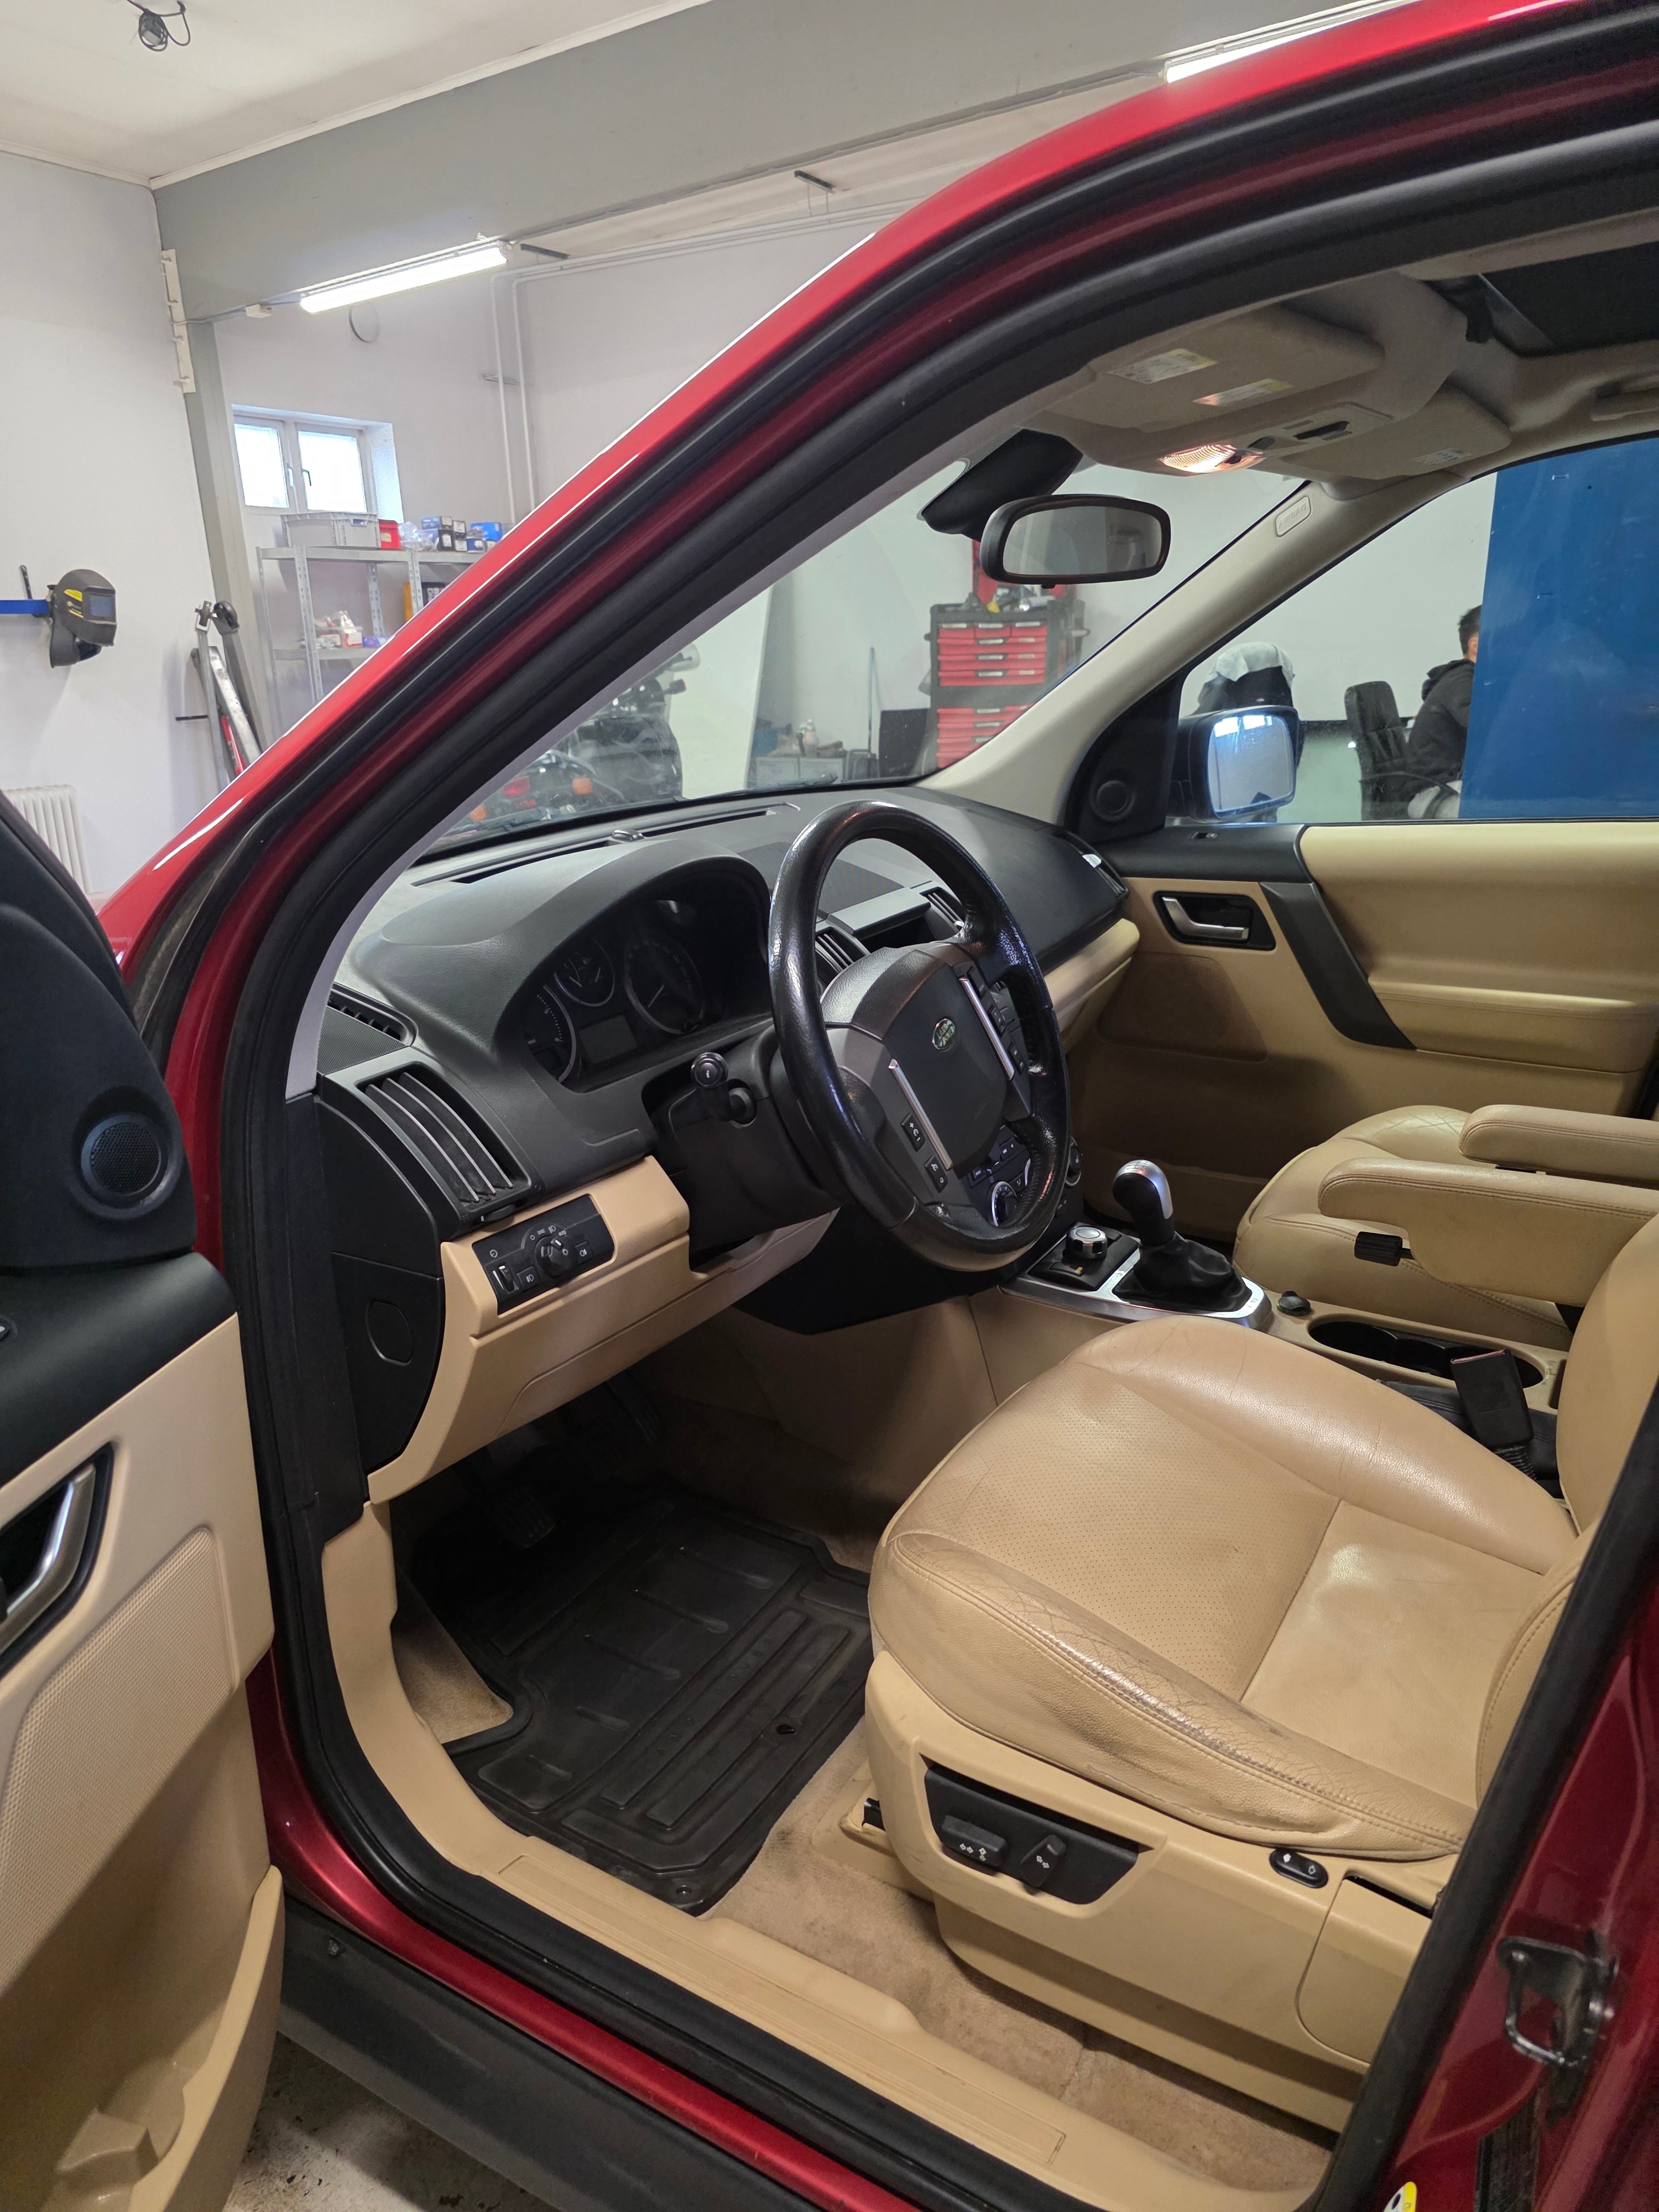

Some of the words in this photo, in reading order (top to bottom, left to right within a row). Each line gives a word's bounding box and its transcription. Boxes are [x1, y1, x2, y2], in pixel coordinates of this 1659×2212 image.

[1279, 503, 1307, 529] AIRBAG
[937, 1023, 948, 1040] LAND
[942, 1026, 954, 1045] ROVER
